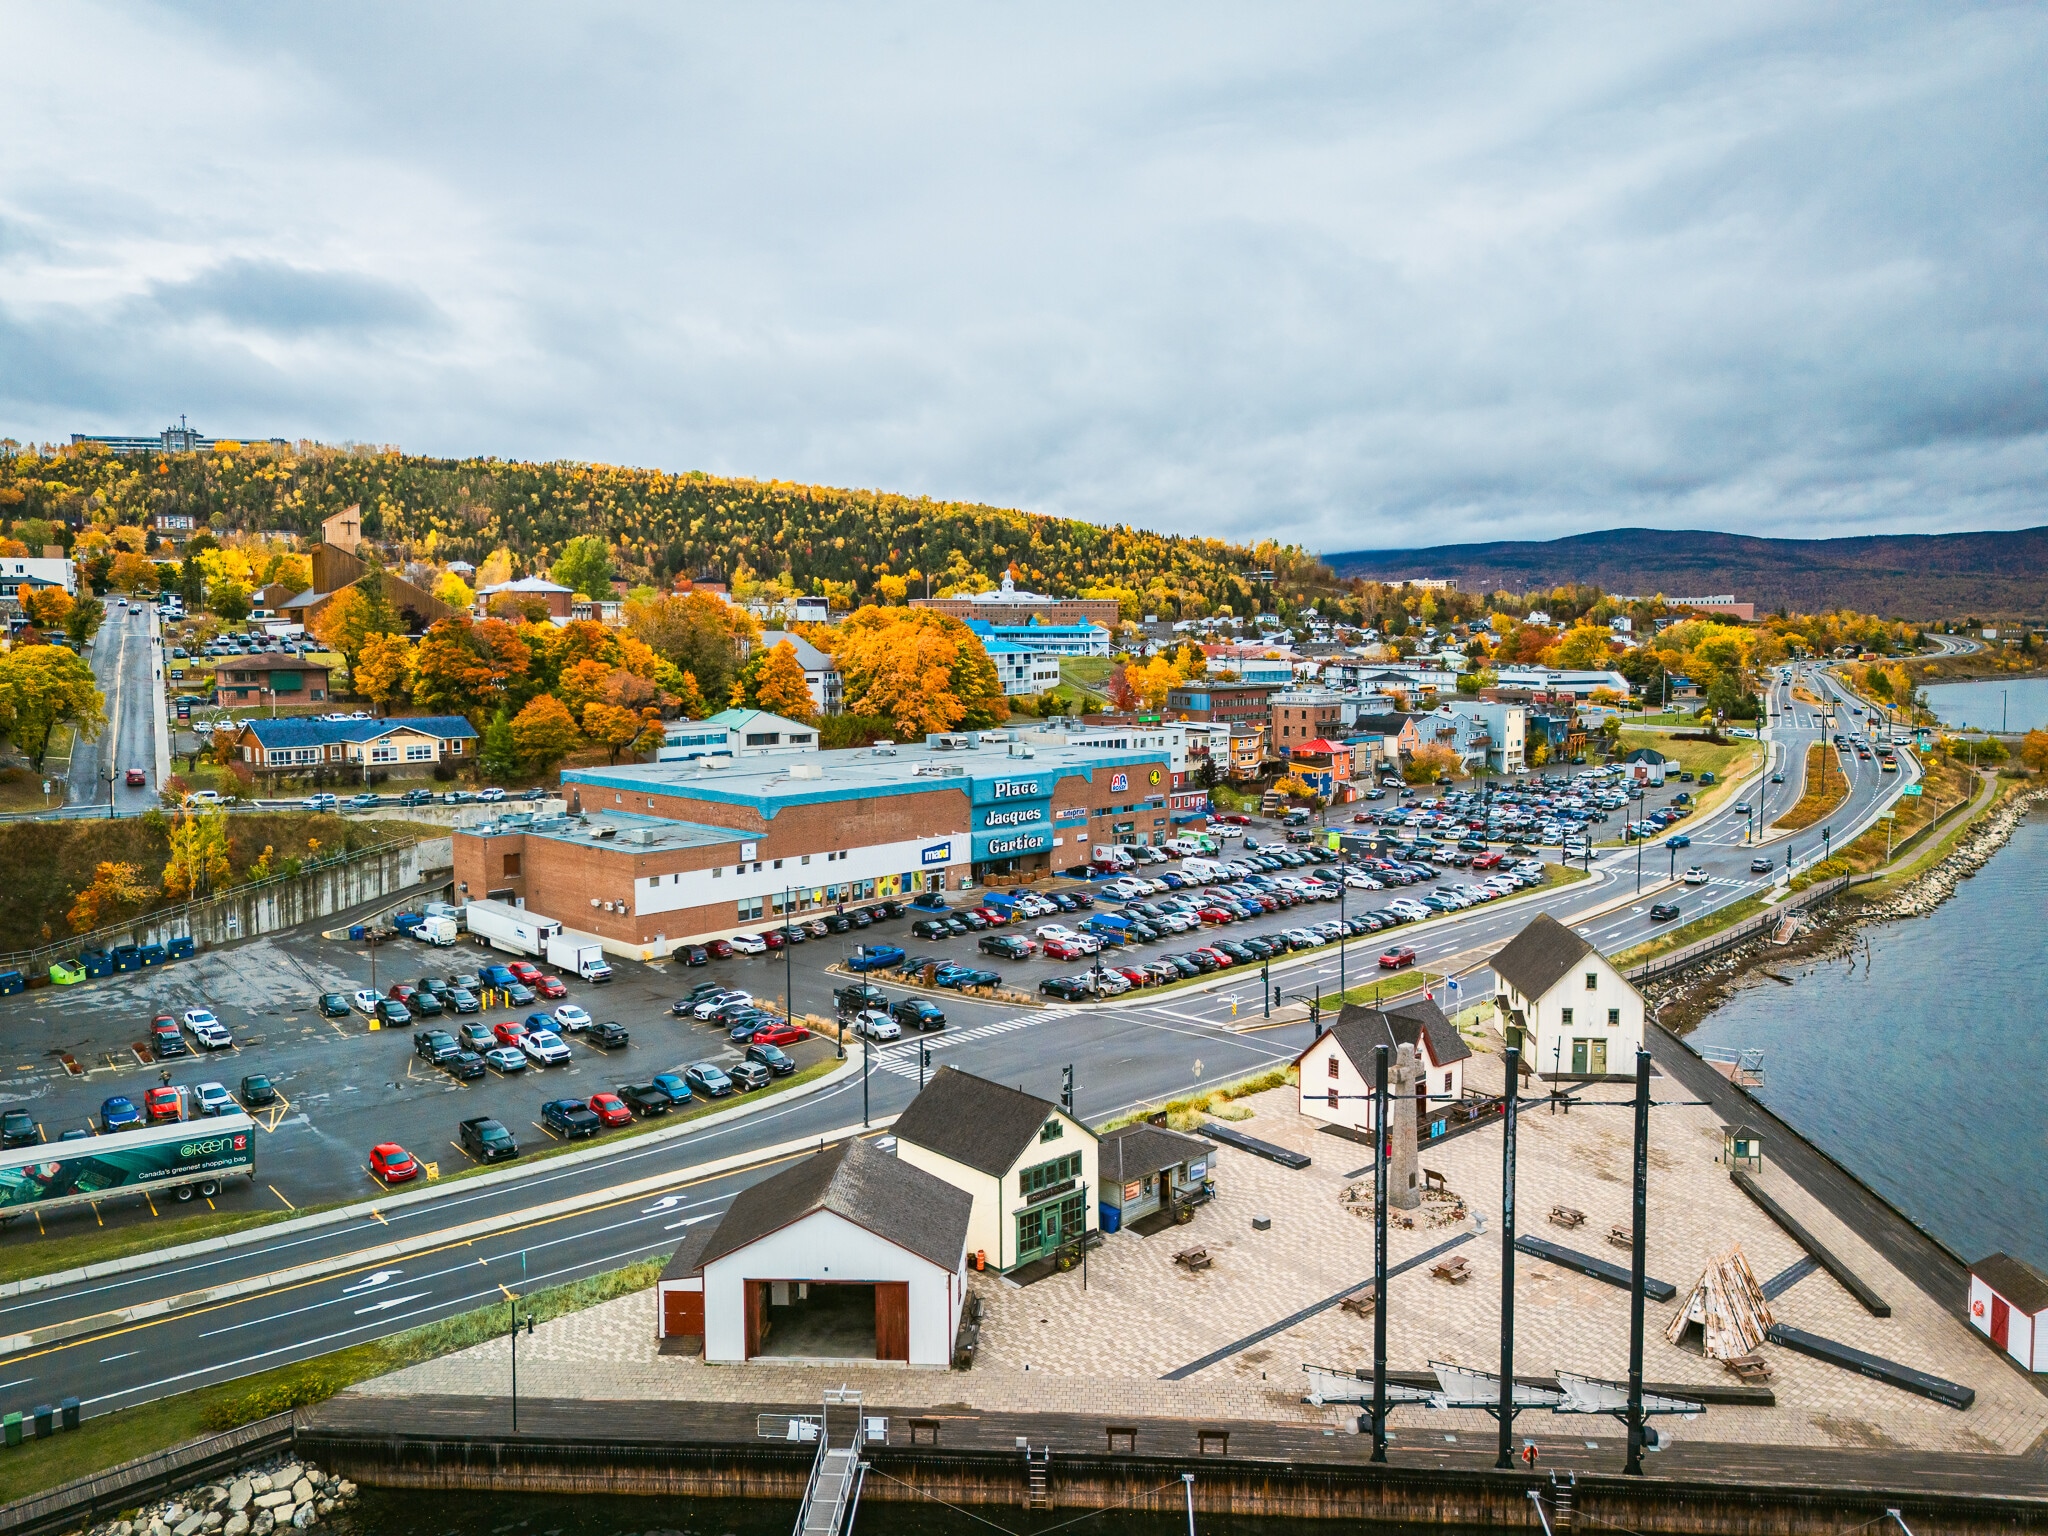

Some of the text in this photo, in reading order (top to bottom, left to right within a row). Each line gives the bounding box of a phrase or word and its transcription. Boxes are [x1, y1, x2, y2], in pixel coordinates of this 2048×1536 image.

[995, 782, 1038, 798] Place
[985, 808, 1042, 826] Jacques
[924, 844, 949, 861] maxi
[138, 1169, 170, 1179] Canada's
[172, 1163, 200, 1174] greenest
[202, 1158, 232, 1167] shopping
